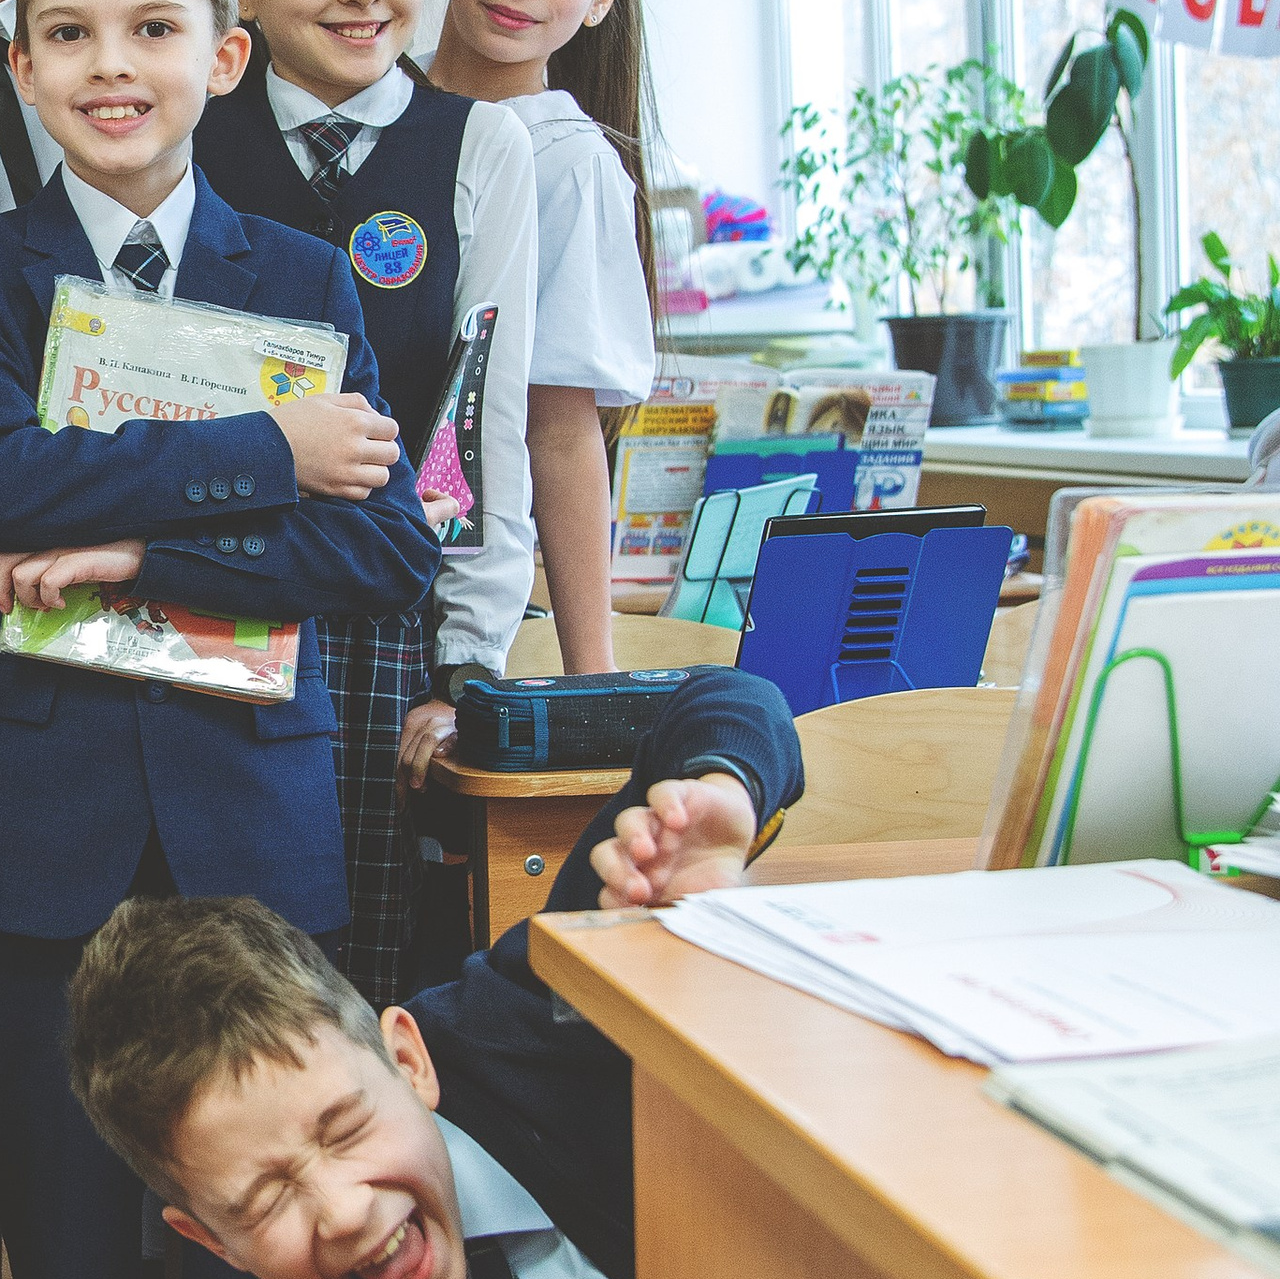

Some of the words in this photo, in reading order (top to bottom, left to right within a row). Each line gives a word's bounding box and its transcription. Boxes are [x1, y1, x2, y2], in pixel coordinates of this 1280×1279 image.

[374, 248, 408, 262] ЛИЦЕЙ
[354, 253, 377, 279] ЦЕНТР
[379, 244, 423, 285] ОБРАЗОВАНИЯ
[384, 262, 402, 274] 83
[306, 350, 326, 362] Тимур
[99, 357, 108, 367] В.
[181, 373, 190, 383] В.
[191, 376, 199, 385] Г.
[200, 378, 247, 396] Горецкий
[68, 365, 219, 422] Русский
[870, 410, 896, 420] ИКА
[862, 439, 889, 450] ЩИЙ
